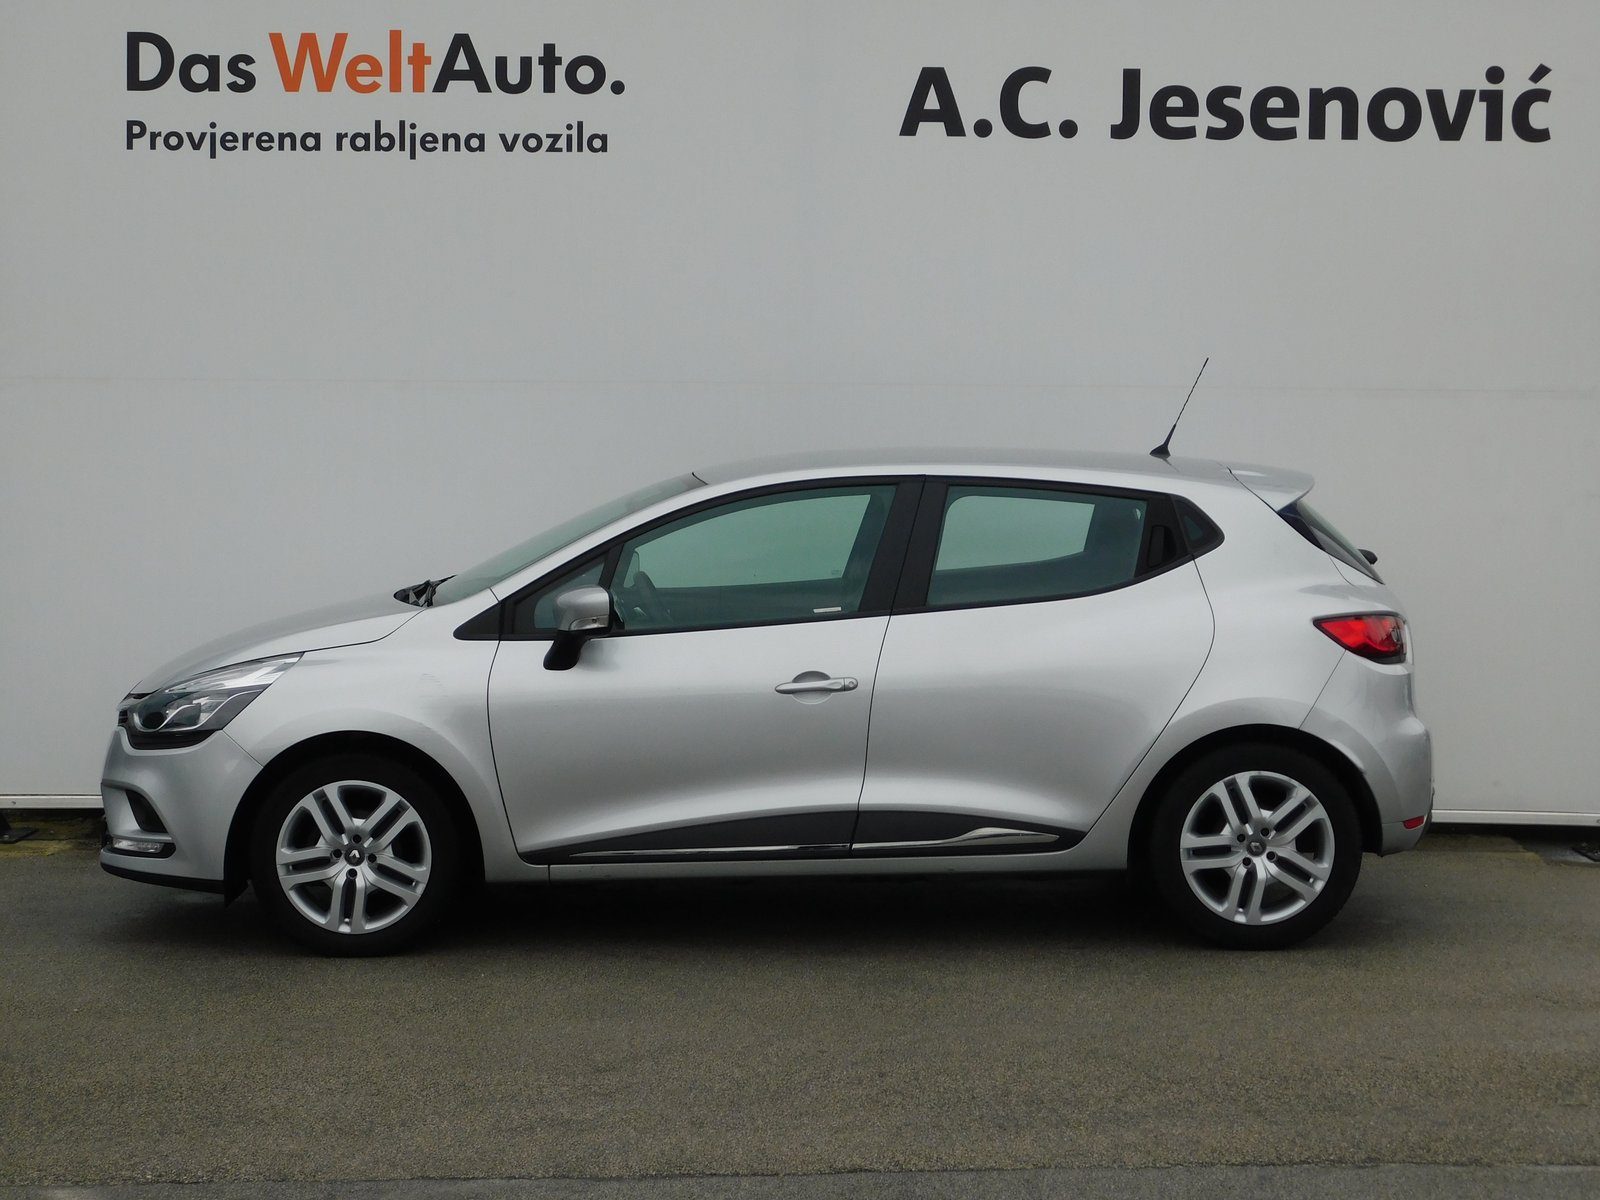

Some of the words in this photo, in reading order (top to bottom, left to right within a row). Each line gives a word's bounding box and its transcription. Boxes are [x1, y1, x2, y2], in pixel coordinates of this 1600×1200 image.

[126, 31, 256, 94] Das
[899, 66, 1078, 140] A.C.
[1110, 63, 1553, 144] Jesenović
[126, 119, 320, 160] Provjerena
[335, 119, 485, 161] rabljena
[498, 120, 608, 154] vozila
